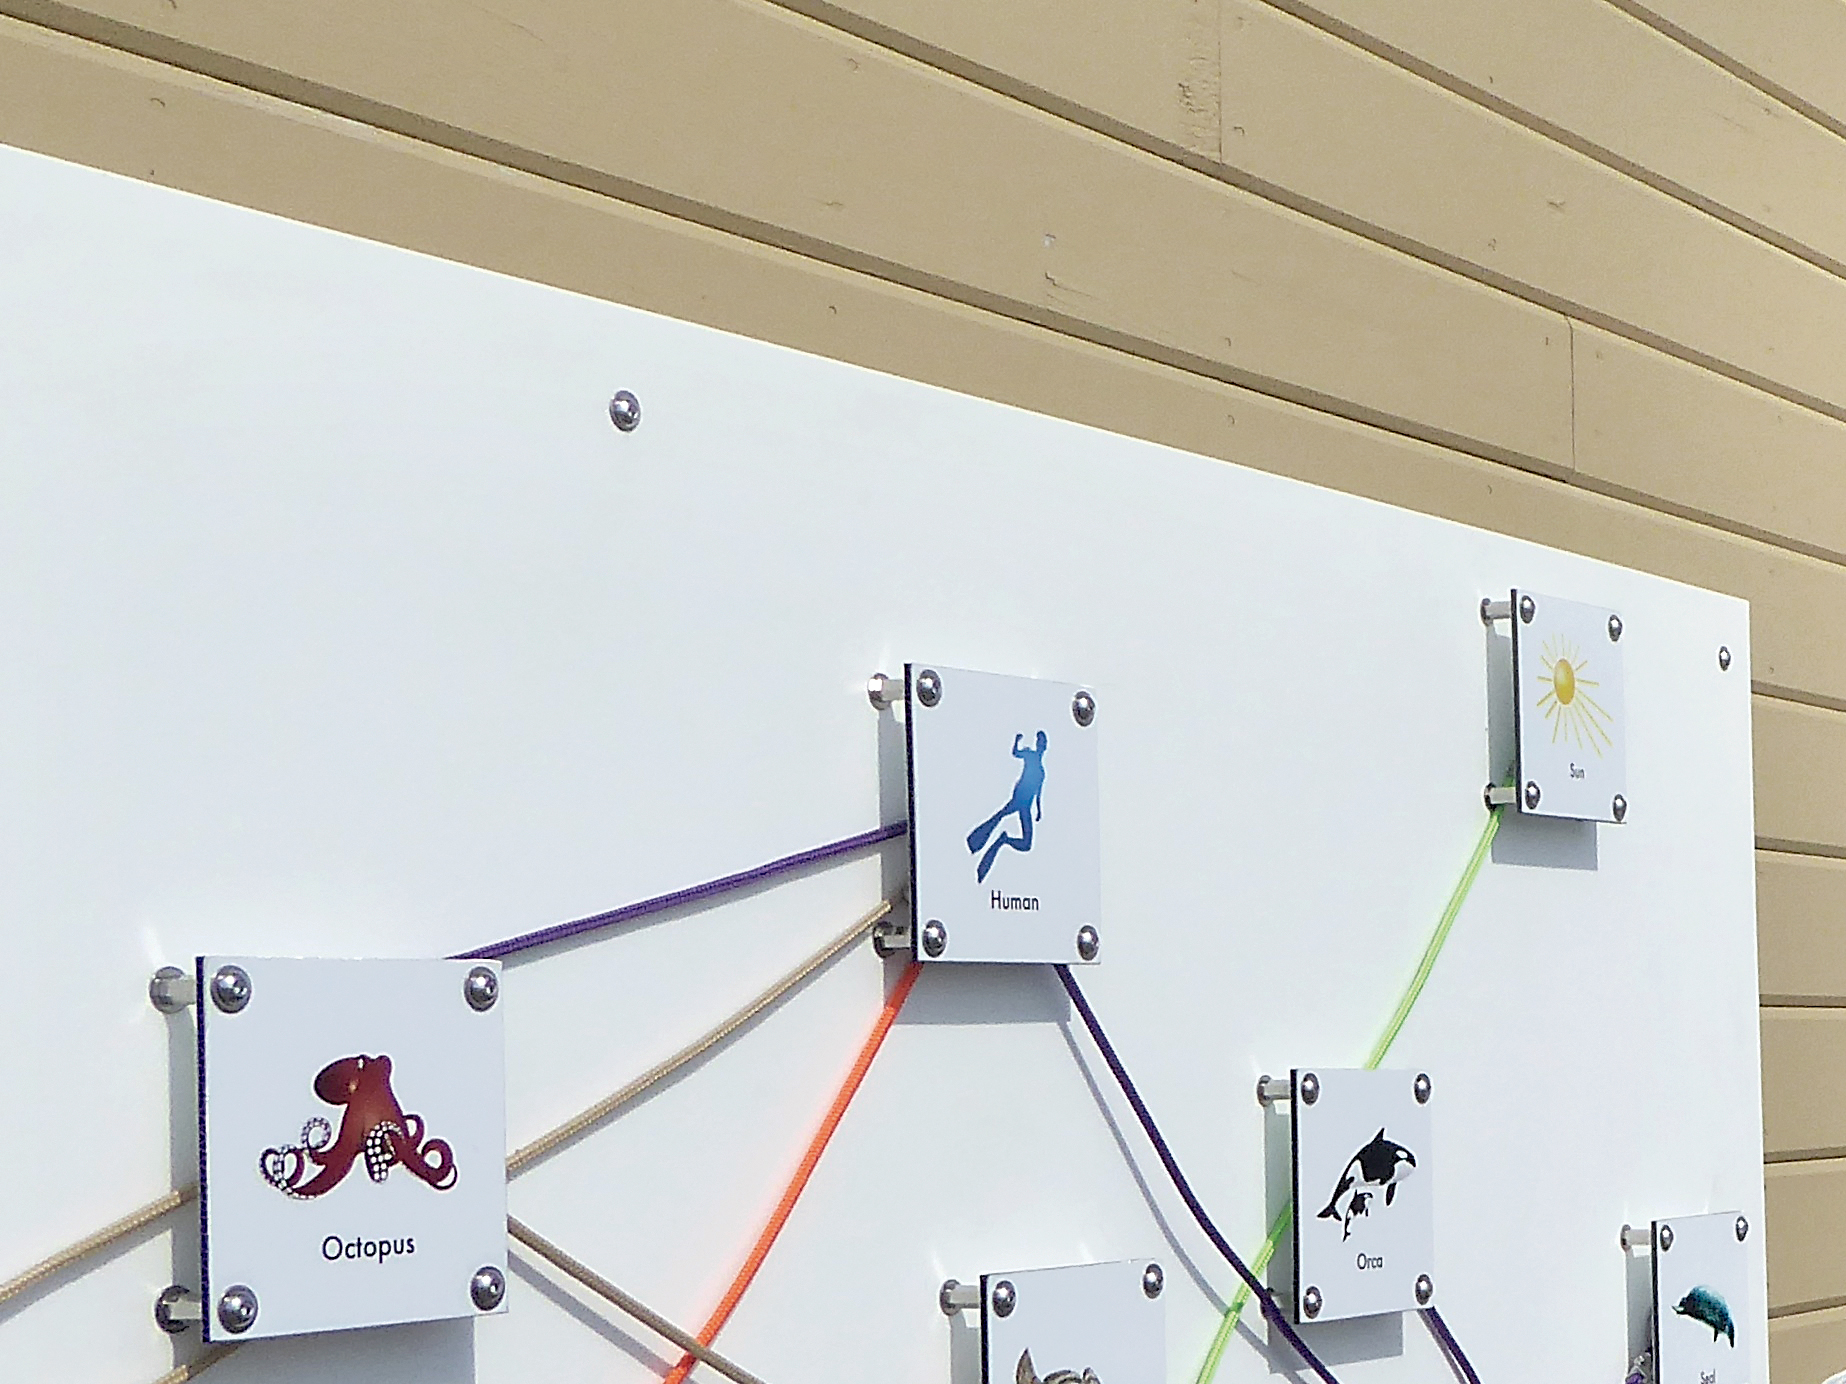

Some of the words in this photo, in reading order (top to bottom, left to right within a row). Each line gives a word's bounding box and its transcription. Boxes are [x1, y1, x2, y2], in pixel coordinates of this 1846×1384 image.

[990, 889, 1040, 912] Human
[321, 1235, 415, 1265] Octopus
[1356, 1252, 1383, 1271] Orca
